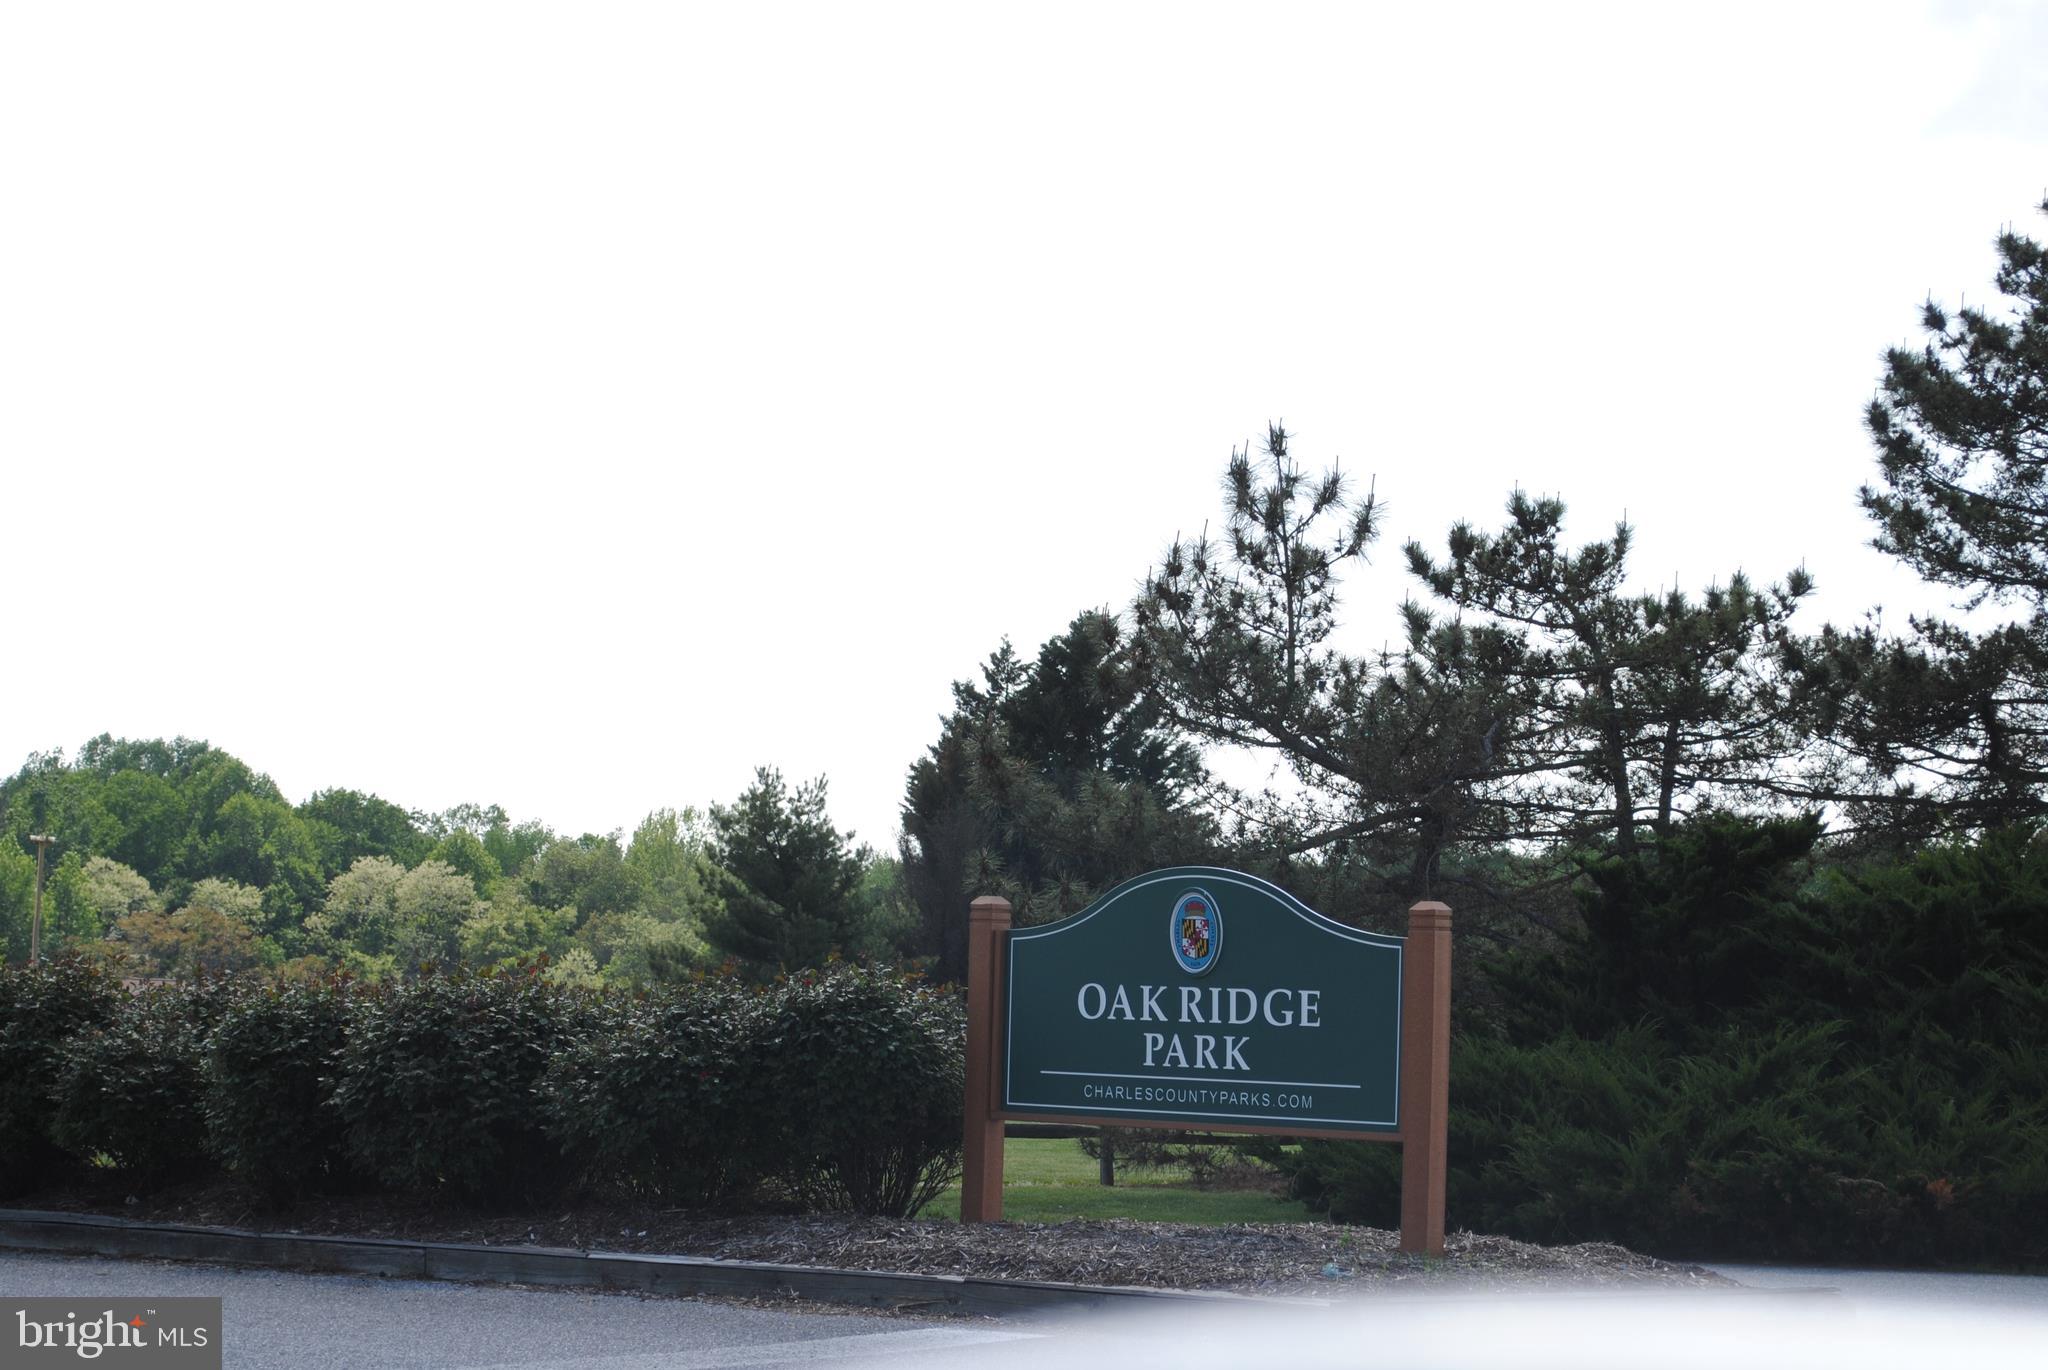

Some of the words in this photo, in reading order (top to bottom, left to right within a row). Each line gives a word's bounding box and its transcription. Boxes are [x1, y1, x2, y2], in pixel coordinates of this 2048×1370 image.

[1077, 982, 1169, 1022] OAK
[1178, 986, 1321, 1027] RIDGE
[1143, 1032, 1250, 1071] PARK
[1083, 1084, 1313, 1109] CHARLESCOUNTYPARKS.COM
